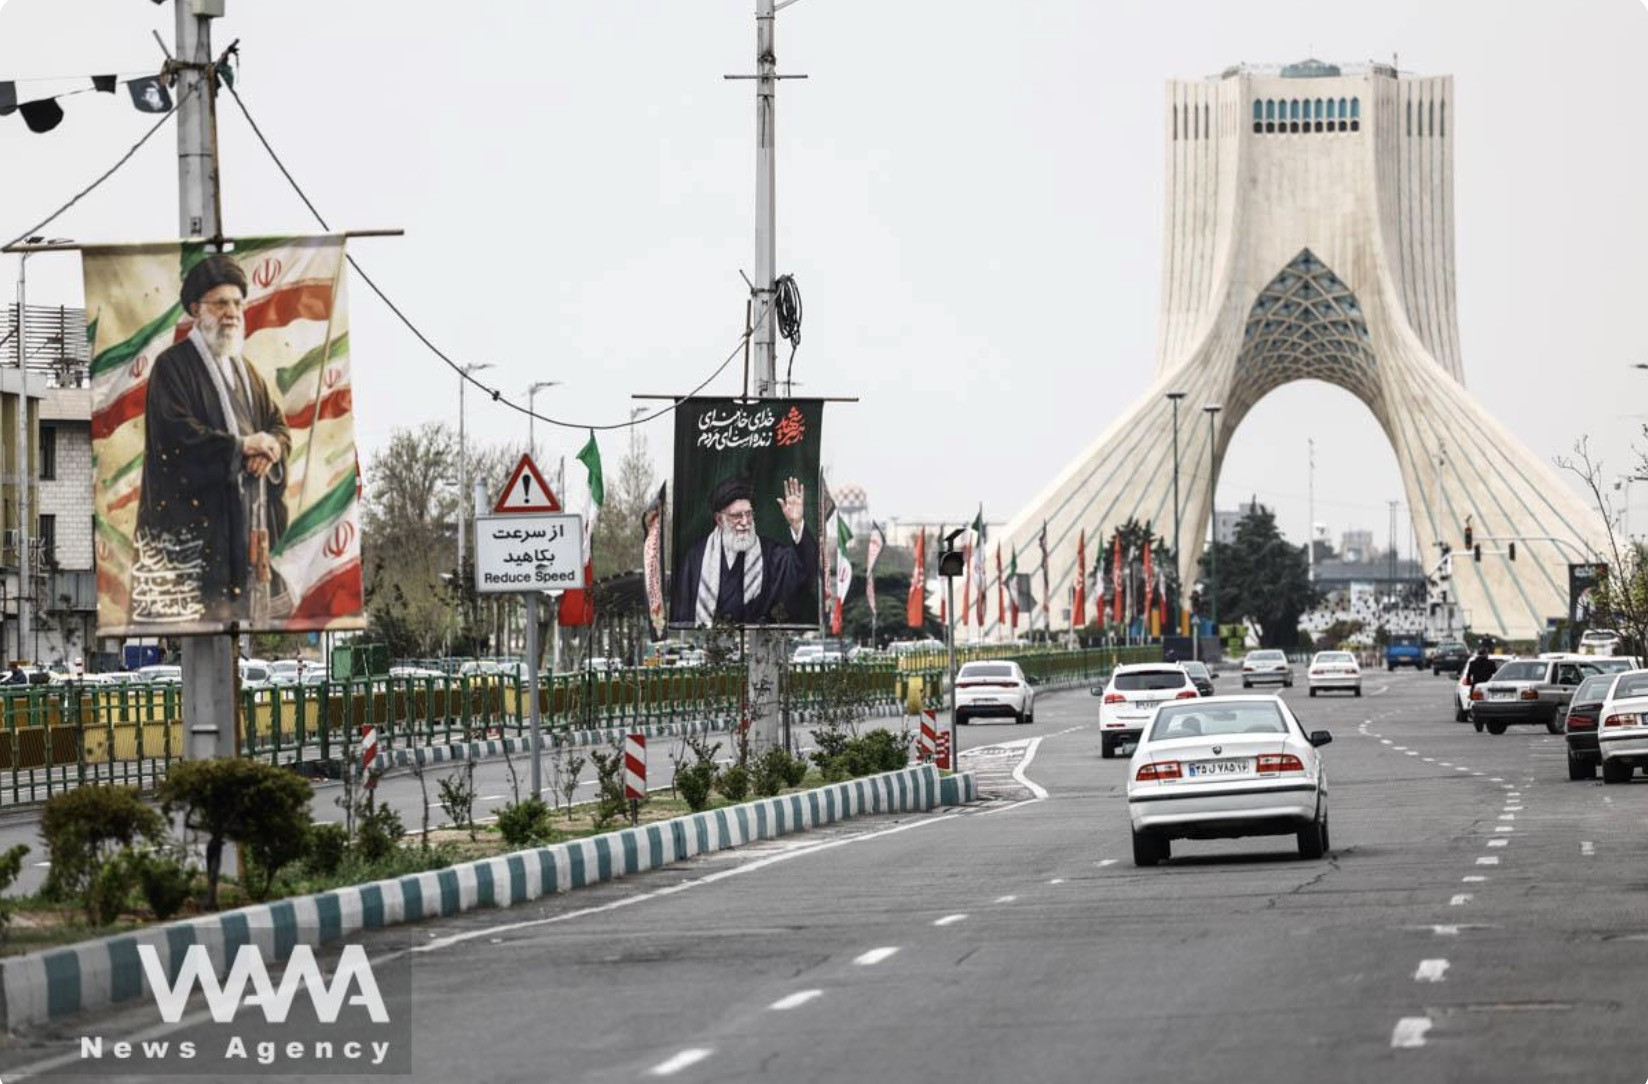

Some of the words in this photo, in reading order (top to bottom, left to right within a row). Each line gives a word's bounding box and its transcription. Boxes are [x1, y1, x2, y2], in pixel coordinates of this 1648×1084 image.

[752, 432, 773, 448] زنده
[492, 529, 547, 543] سرعت
[548, 524, 564, 542] از
[503, 549, 555, 567] بکاهید
[484, 572, 531, 583] Reduce
[535, 569, 575, 584] Speed
